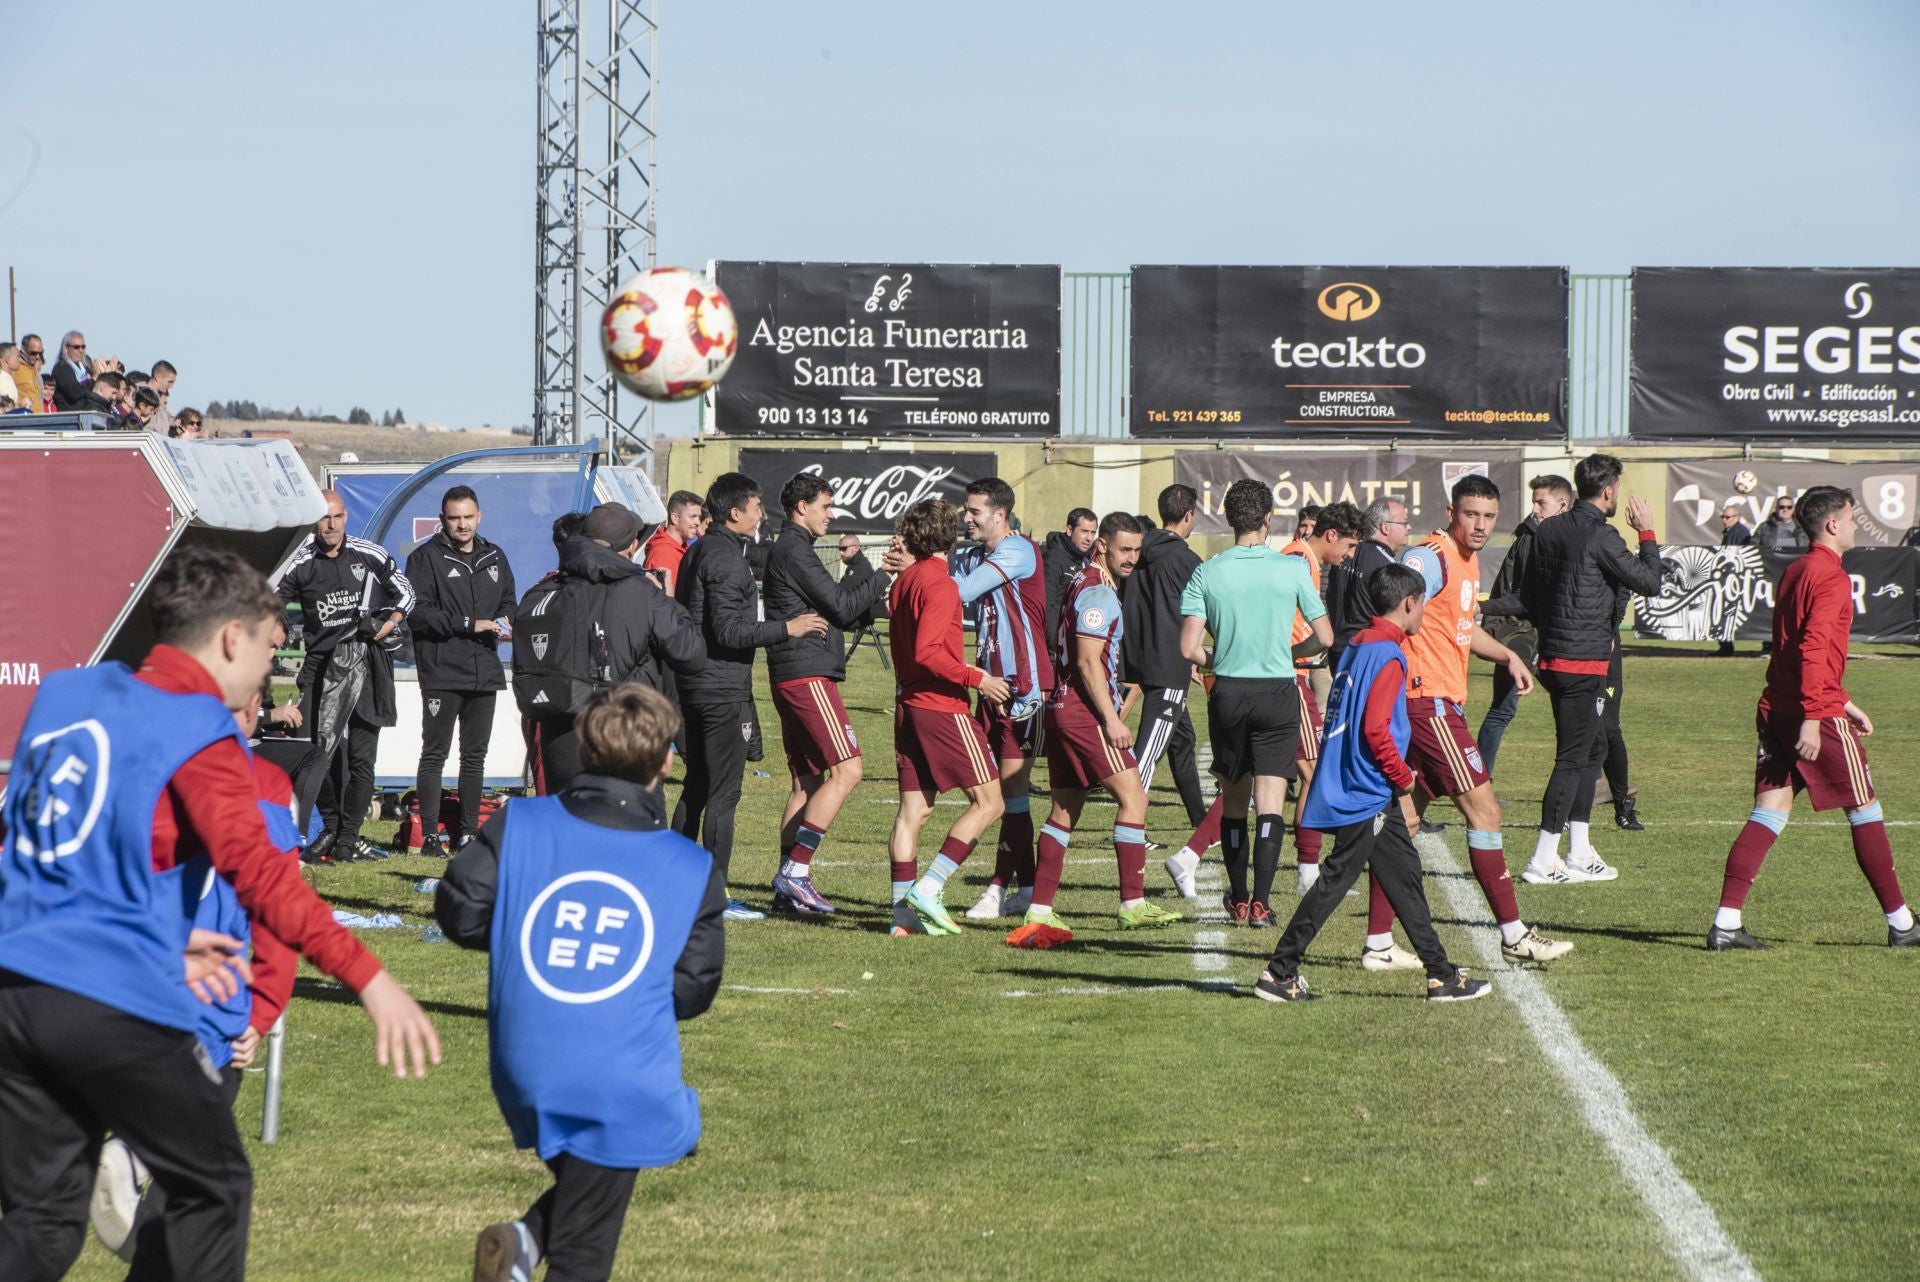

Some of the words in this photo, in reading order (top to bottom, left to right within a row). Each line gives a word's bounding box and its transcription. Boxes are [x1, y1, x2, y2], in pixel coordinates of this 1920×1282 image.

[749, 317, 875, 354] Agencia
[883, 319, 1029, 349] Funeraria
[1270, 336, 1426, 369] teckto
[1723, 325, 1920, 374] SEGES
[793, 357, 878, 387] Santa
[884, 358, 984, 388] Teresa
[1318, 390, 1377, 403] EMPRESA
[1722, 383, 1760, 401] Obra
[1763, 383, 1794, 401] Civil
[1821, 383, 1898, 401] Edificación
[758, 407, 791, 425] 900
[795, 407, 817, 425] 13
[821, 408, 843, 425] 13
[847, 408, 870, 425] 14
[904, 406, 978, 425] TELÉFONO
[980, 411, 1050, 425] GRATUITO
[1147, 409, 1170, 423] Tel.
[1172, 409, 1193, 423] 921
[1195, 409, 1217, 423] 439
[1219, 409, 1242, 423] 365
[1299, 404, 1396, 418] CONSTRUCTORA
[1443, 409, 1551, 424] teckto@teckto.es
[800, 463, 955, 520] ca-Col
[1203, 470, 1421, 516] ¡AÓNATE!
[1879, 480, 1905, 520] 8
[0, 662, 40, 685] ANA
